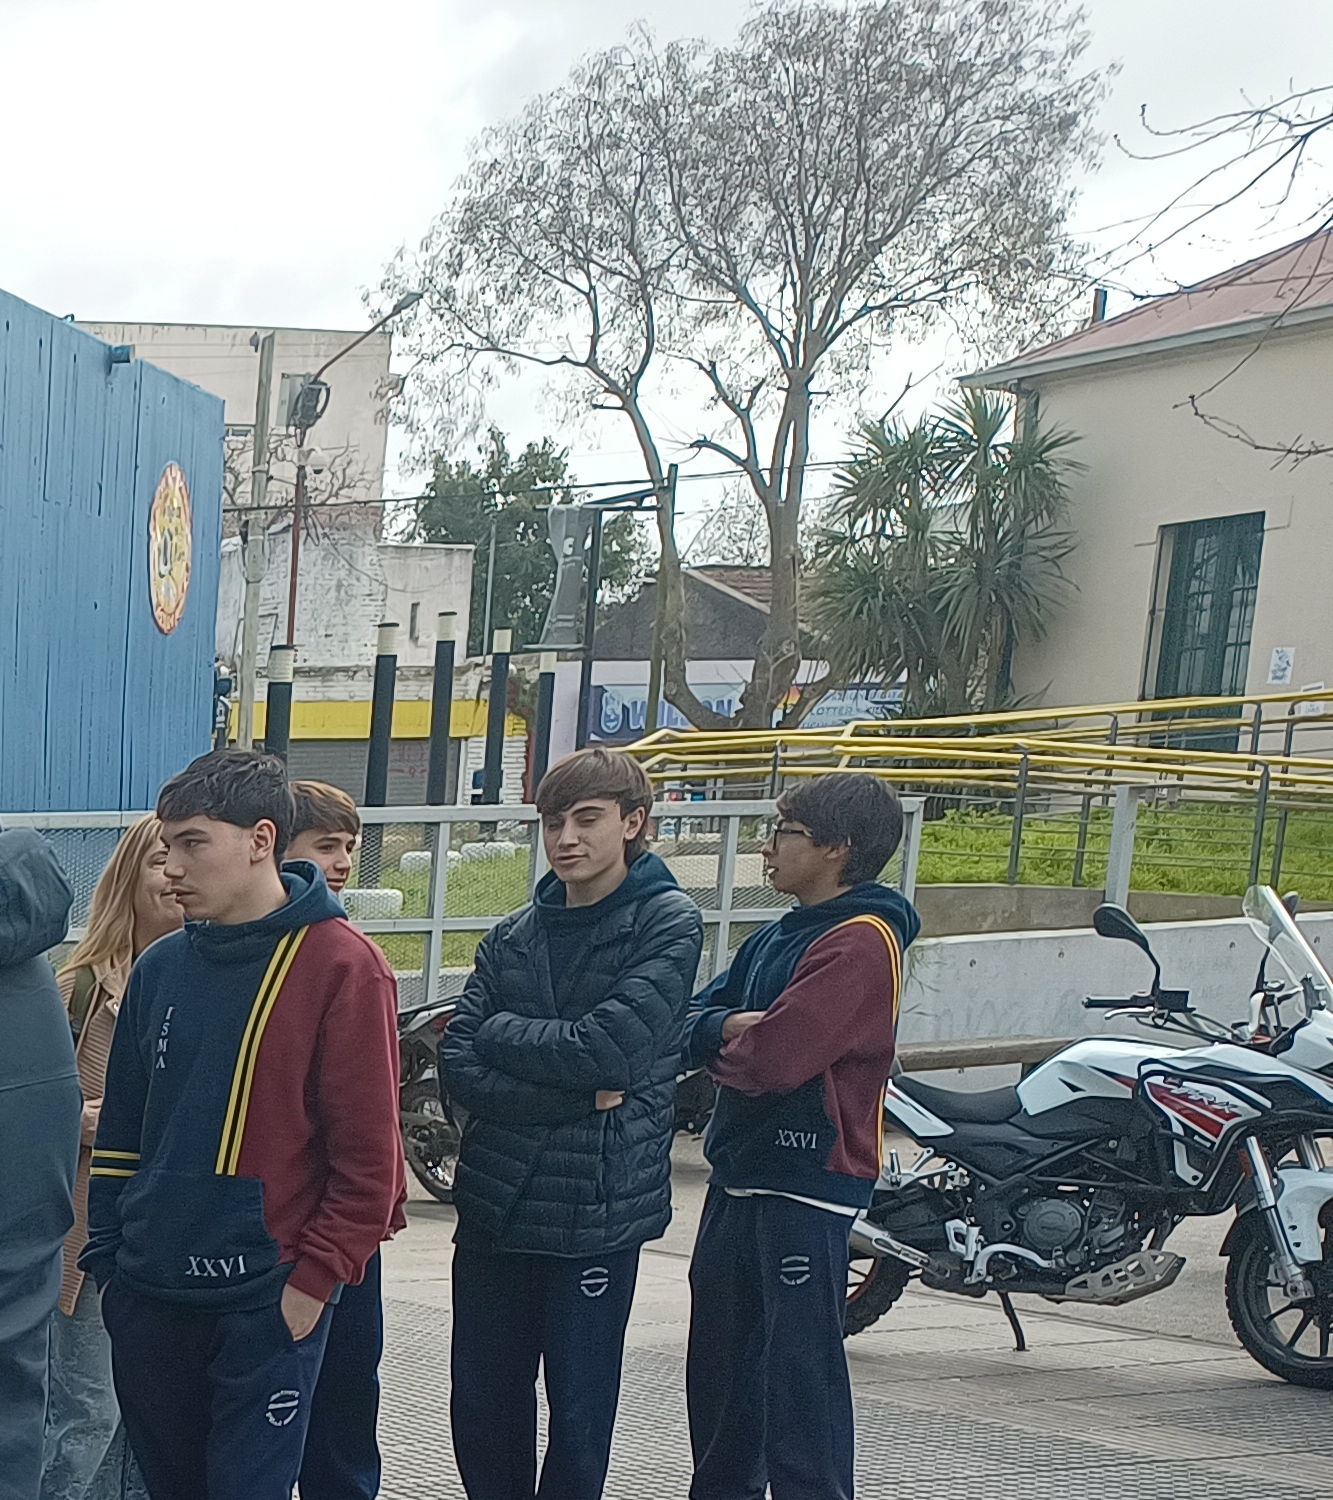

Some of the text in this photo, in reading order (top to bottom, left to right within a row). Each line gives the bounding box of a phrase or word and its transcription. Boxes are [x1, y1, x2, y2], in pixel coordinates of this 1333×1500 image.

[155, 1005, 175, 1070] ISMA
[775, 1128, 817, 1150] XXVI
[184, 1254, 247, 1279] XXVI
